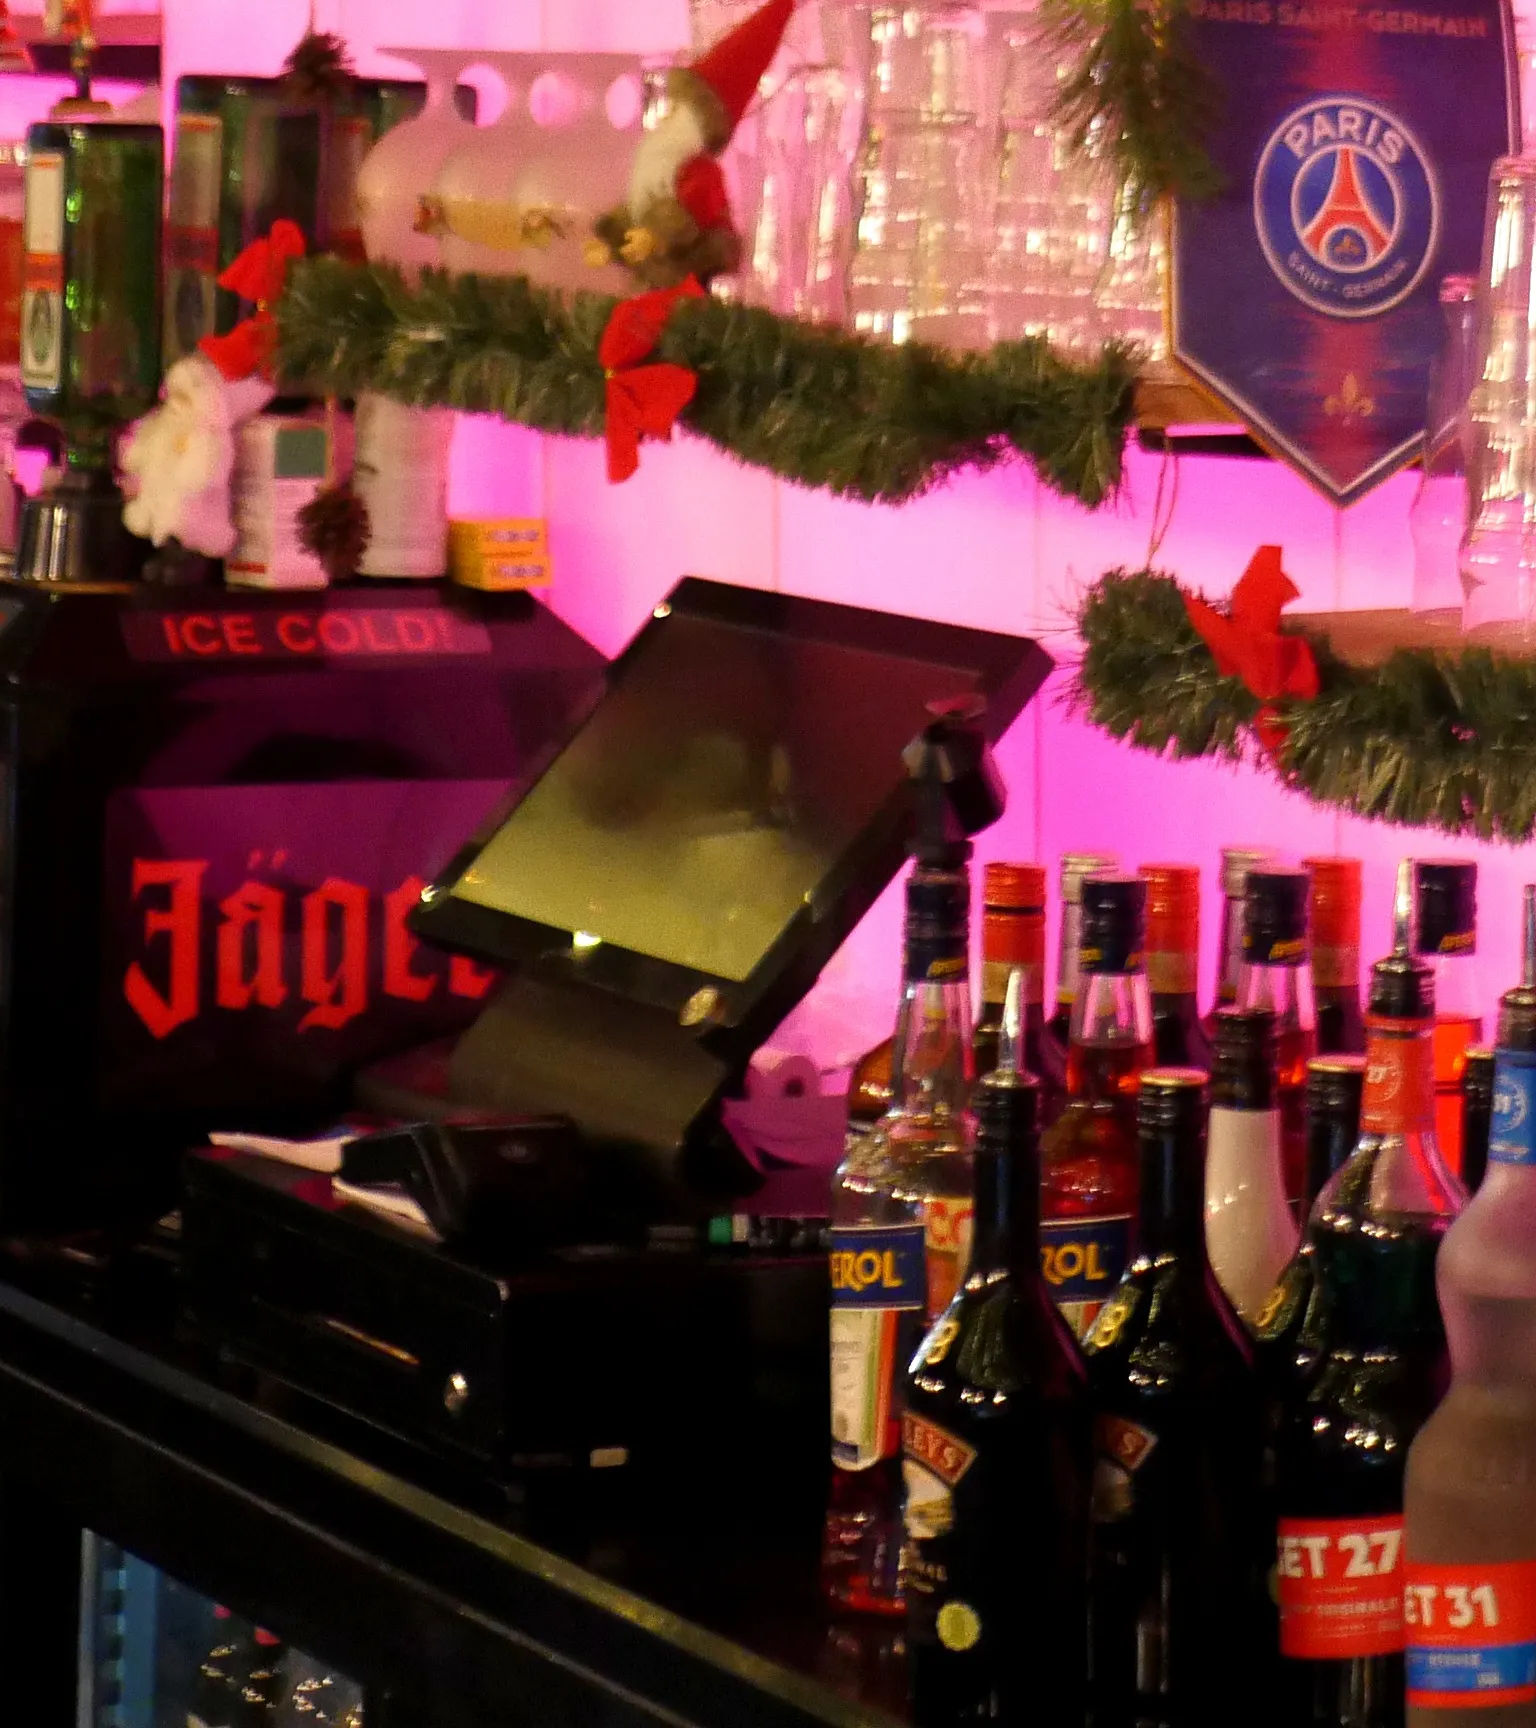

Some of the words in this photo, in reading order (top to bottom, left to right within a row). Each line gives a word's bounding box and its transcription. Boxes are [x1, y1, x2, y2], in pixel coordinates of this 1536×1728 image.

[1283, 108, 1405, 166] PARIS
[164, 614, 263, 656] ICE
[1278, 1535, 1330, 1580] ET
[1338, 1528, 1402, 1579] 27
[1444, 1583, 1500, 1630] 31
